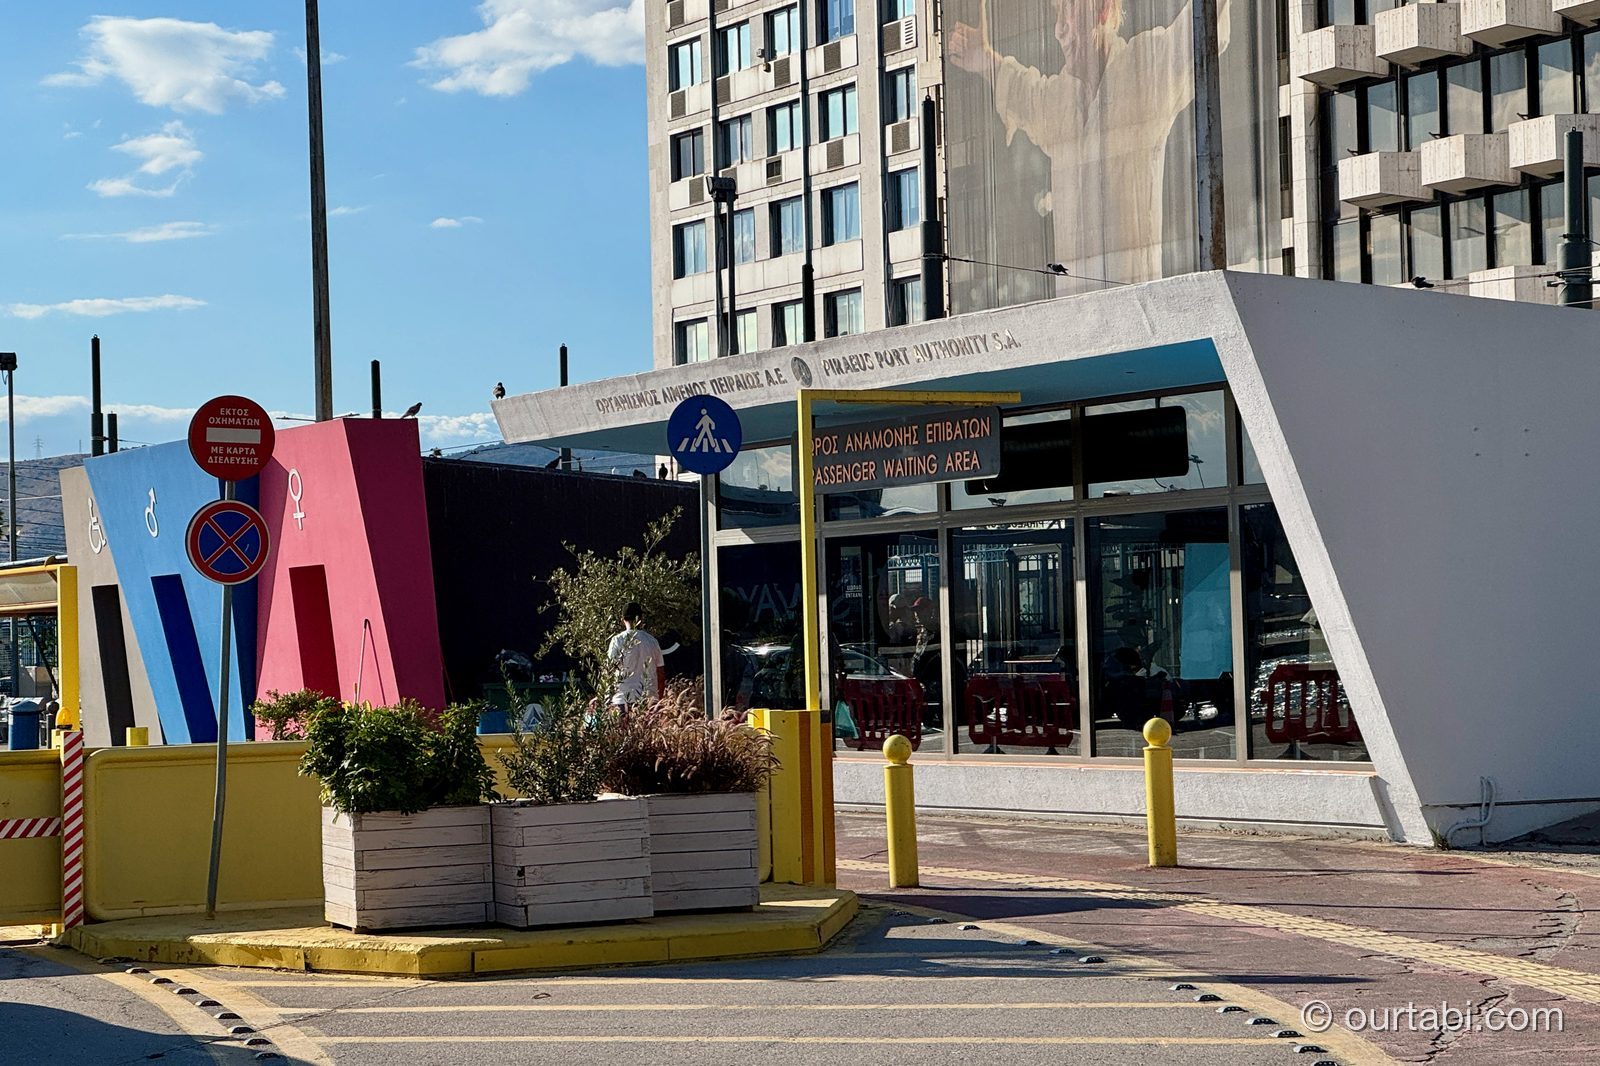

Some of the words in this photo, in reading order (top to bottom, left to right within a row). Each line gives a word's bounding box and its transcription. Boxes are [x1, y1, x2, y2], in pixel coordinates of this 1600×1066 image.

[821, 352, 875, 377] PIRAEUS
[876, 347, 911, 369] PORT
[912, 334, 990, 364] AUTHORITY
[991, 328, 1023, 352] S.A.
[595, 389, 661, 414] ΟΡΓΑΝΙΣΜΟΣ
[709, 371, 764, 396] ΠΕΙΡΑΙΩΣ
[764, 367, 788, 387] Α.Ε.
[208, 416, 260, 426] ΟΧΗΜΑΤΩΝ
[220, 407, 249, 417] ΕΚΤΟΣ
[811, 435, 839, 457] ΡΟΣ
[845, 425, 919, 452] ΑΝΑΜΟΝΗΣ
[926, 416, 992, 444] ΕΠΙΒΑΤΩΝ
[207, 456, 259, 465] ΔΙΕΛΕΥΣΗΣ
[210, 446, 225, 454] ΜΕ
[226, 446, 256, 455] ΚΑΡΤΑ
[812, 461, 877, 486] ASSENGER
[883, 454, 938, 478] WAITING
[945, 450, 981, 473] AREA
